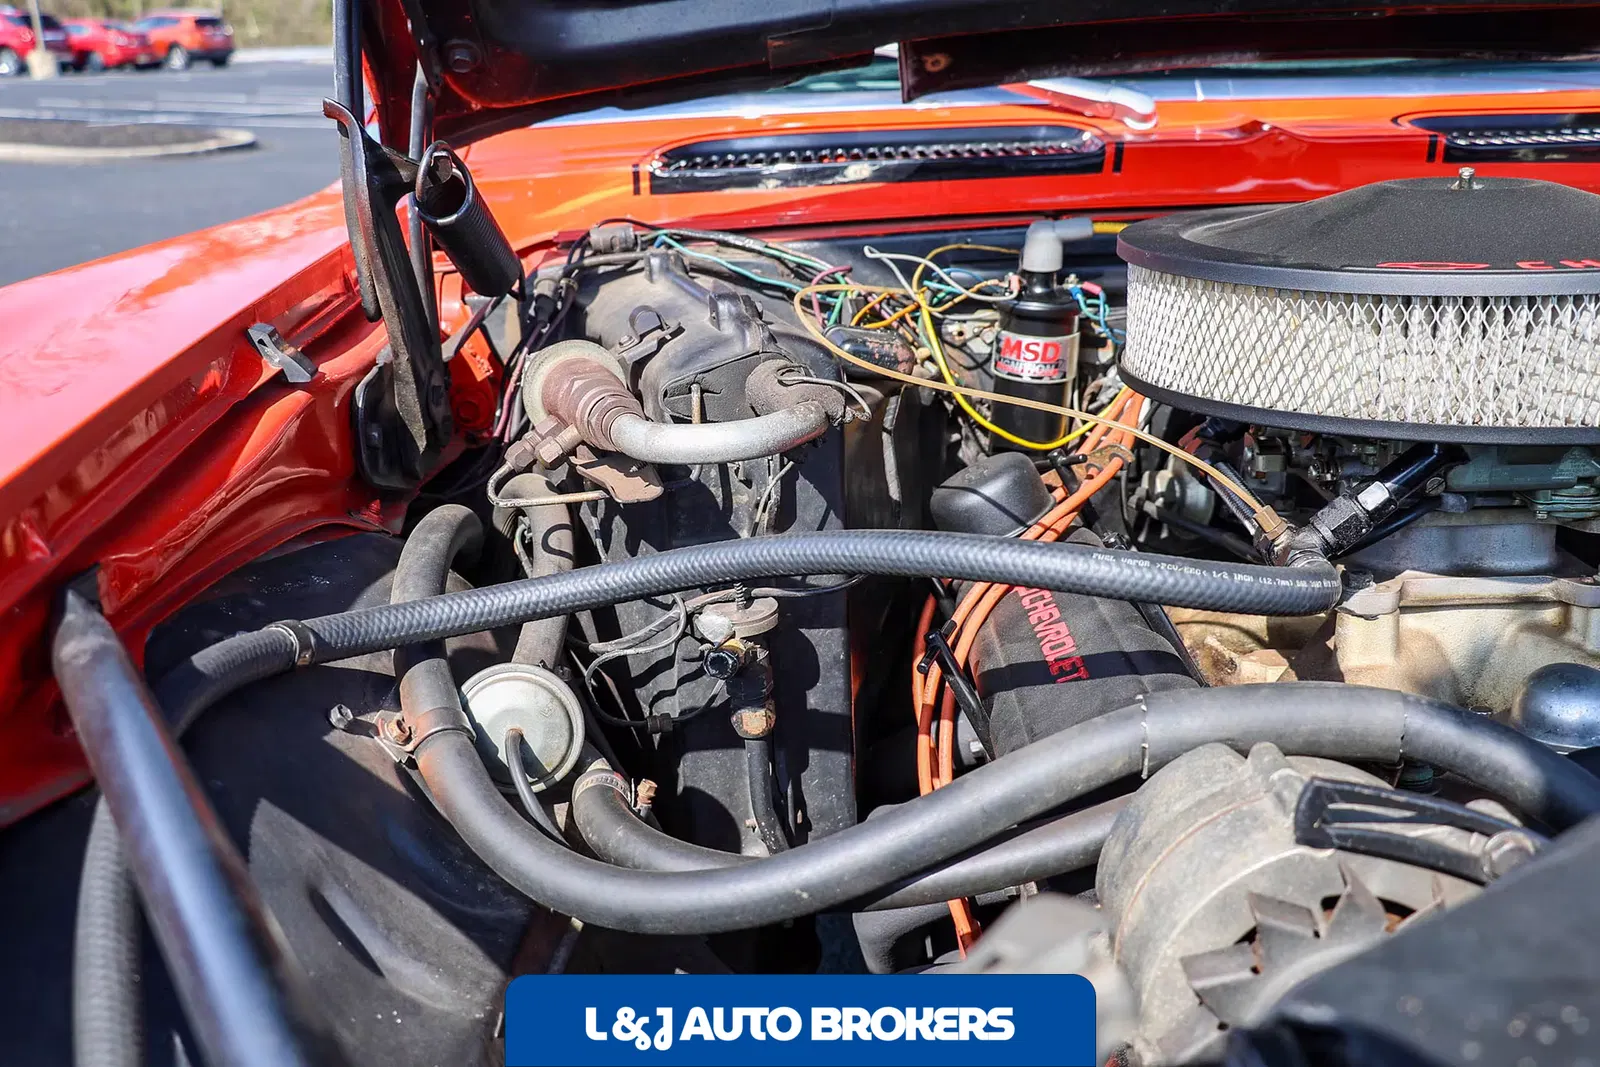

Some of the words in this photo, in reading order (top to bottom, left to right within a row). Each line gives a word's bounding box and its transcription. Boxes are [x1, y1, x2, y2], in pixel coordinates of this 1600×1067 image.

[1000, 336, 1062, 363] MSD
[1092, 552, 1116, 562] FUEL
[1121, 557, 1150, 567] VAPOR
[1212, 570, 1229, 579] 1/2
[1233, 572, 1254, 582] INCH
[1021, 589, 1090, 684] CHEVROLET
